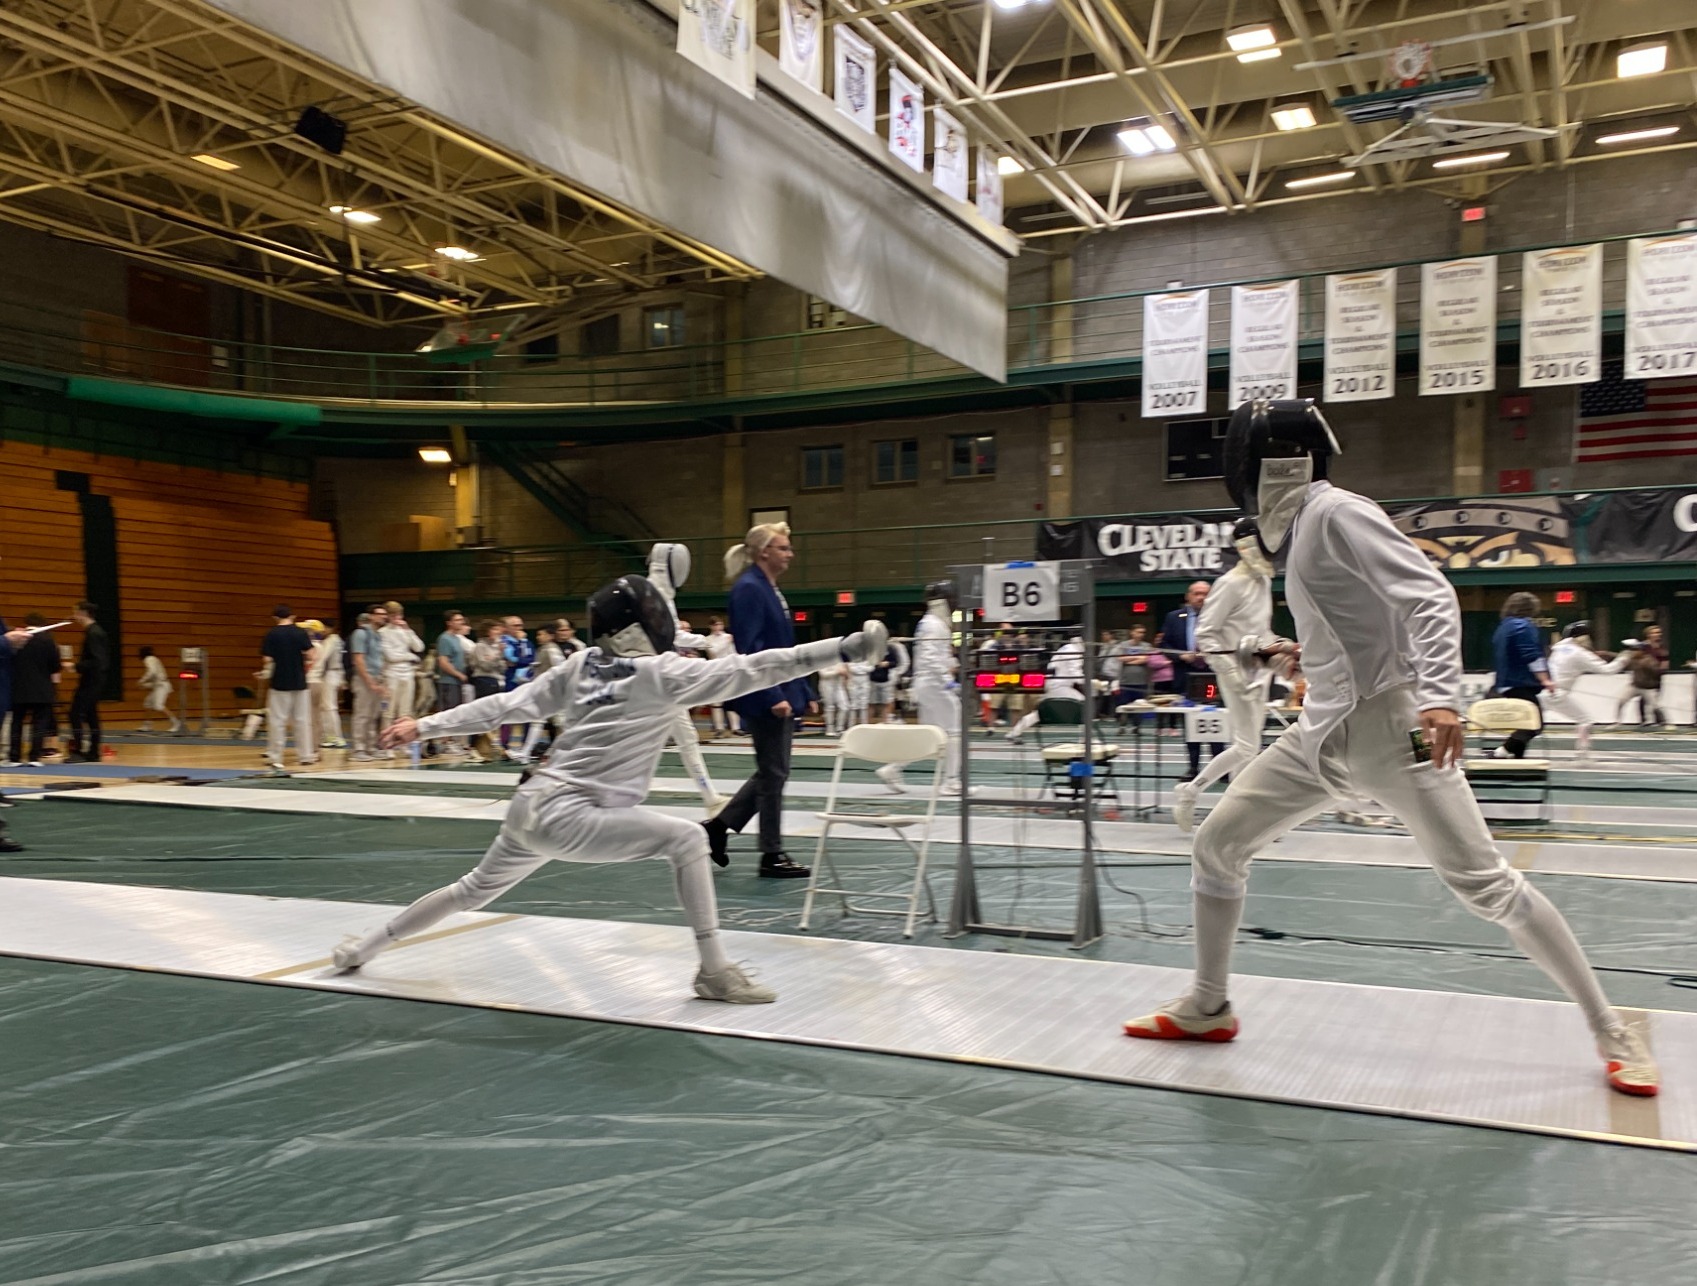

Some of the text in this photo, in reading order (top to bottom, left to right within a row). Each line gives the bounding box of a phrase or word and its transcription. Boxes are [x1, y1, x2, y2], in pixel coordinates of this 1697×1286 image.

[1531, 360, 1591, 380] 2016
[1637, 351, 1697, 371] 2017
[1333, 375, 1385, 394] 2012
[1429, 369, 1484, 389] 2015
[1150, 391, 1198, 409] 2007
[1238, 384, 1288, 402] 2009
[1097, 522, 1236, 556] CLEVELAN
[1140, 547, 1224, 572] STATE
[1003, 582, 1041, 606] B6
[1206, 684, 1215, 698] 3
